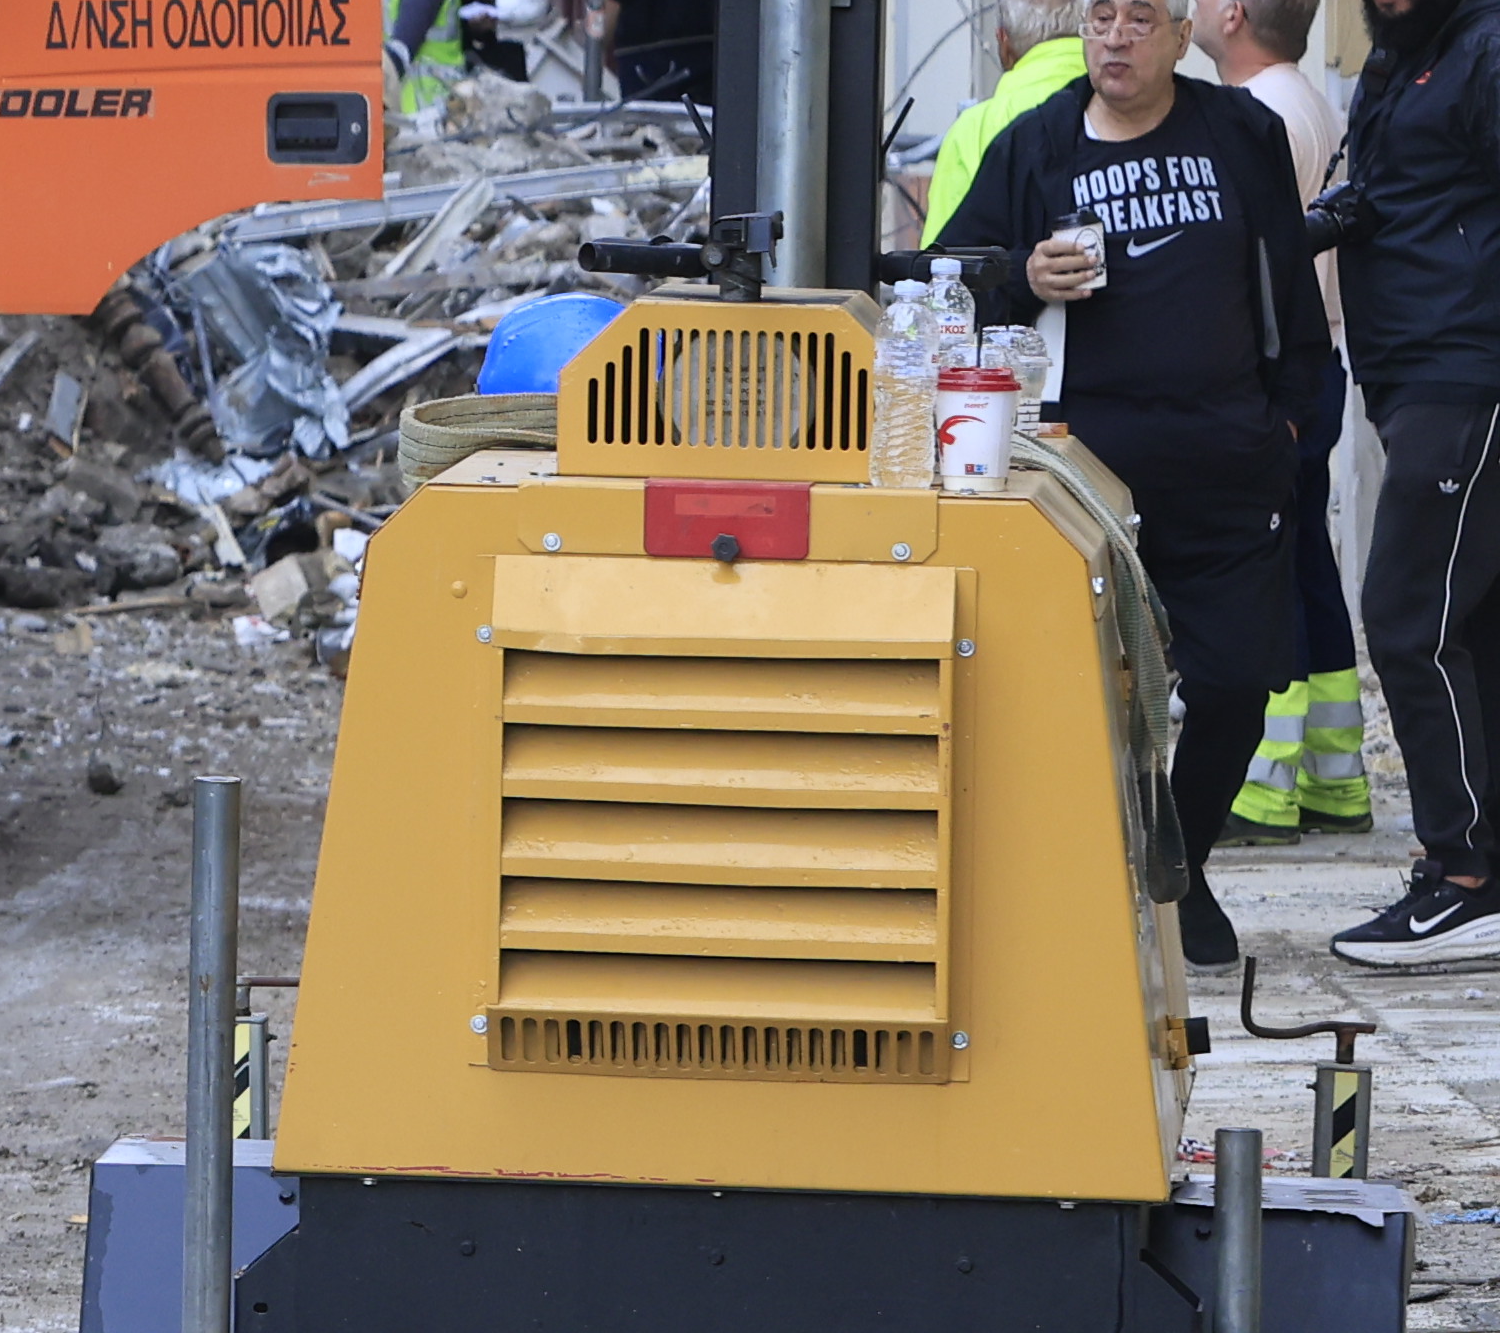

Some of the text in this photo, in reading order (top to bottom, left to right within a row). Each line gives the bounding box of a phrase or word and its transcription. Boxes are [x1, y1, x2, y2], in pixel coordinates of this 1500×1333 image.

[1072, 155, 1217, 207] HOOPS FOR
[1077, 189, 1223, 234] REAKFAST
